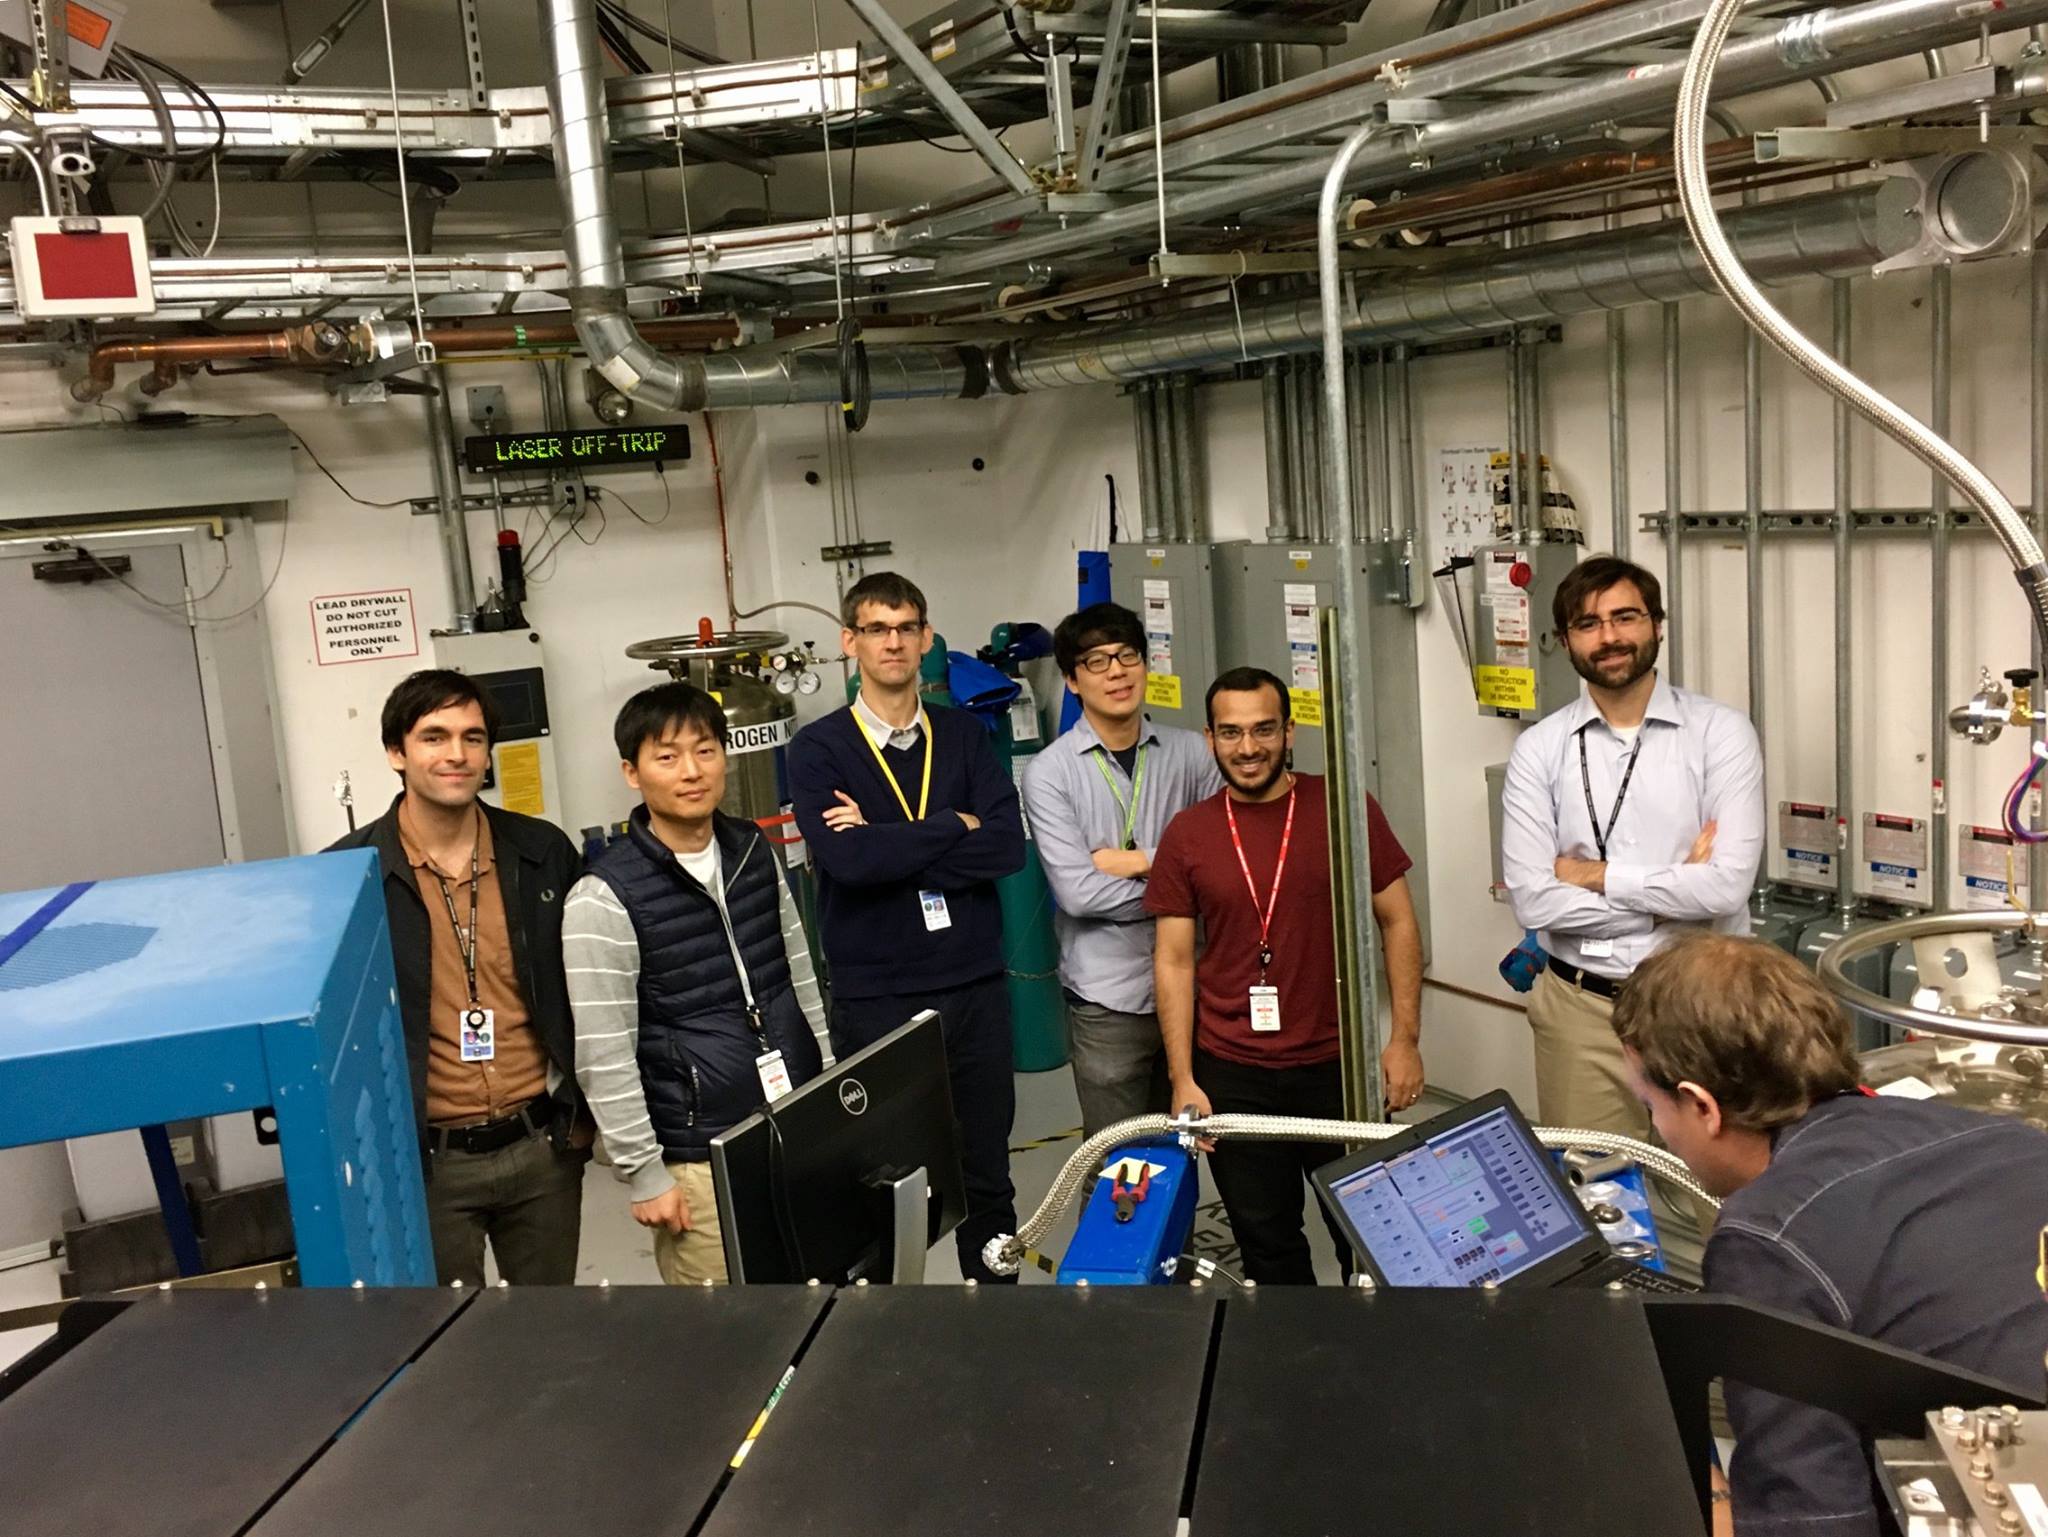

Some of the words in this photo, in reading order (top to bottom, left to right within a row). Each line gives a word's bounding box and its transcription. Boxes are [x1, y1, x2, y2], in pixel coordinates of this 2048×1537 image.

[495, 438, 564, 461] LASER
[571, 431, 667, 456] OFF-TRIP
[316, 601, 347, 610] LEAD
[350, 595, 406, 608] DRYWALL
[326, 613, 343, 622] DO
[346, 610, 371, 620] NOT
[374, 608, 398, 617] CUT
[325, 619, 402, 634] AUTHORIZED
[329, 634, 401, 648] PERSONNEL
[350, 646, 384, 656] ONLY
[1795, 851, 1823, 862] NOTICE
[1879, 865, 1910, 877] NOTICE
[1975, 879, 2008, 893] NOTICE
[843, 1088, 864, 1105] DELL
